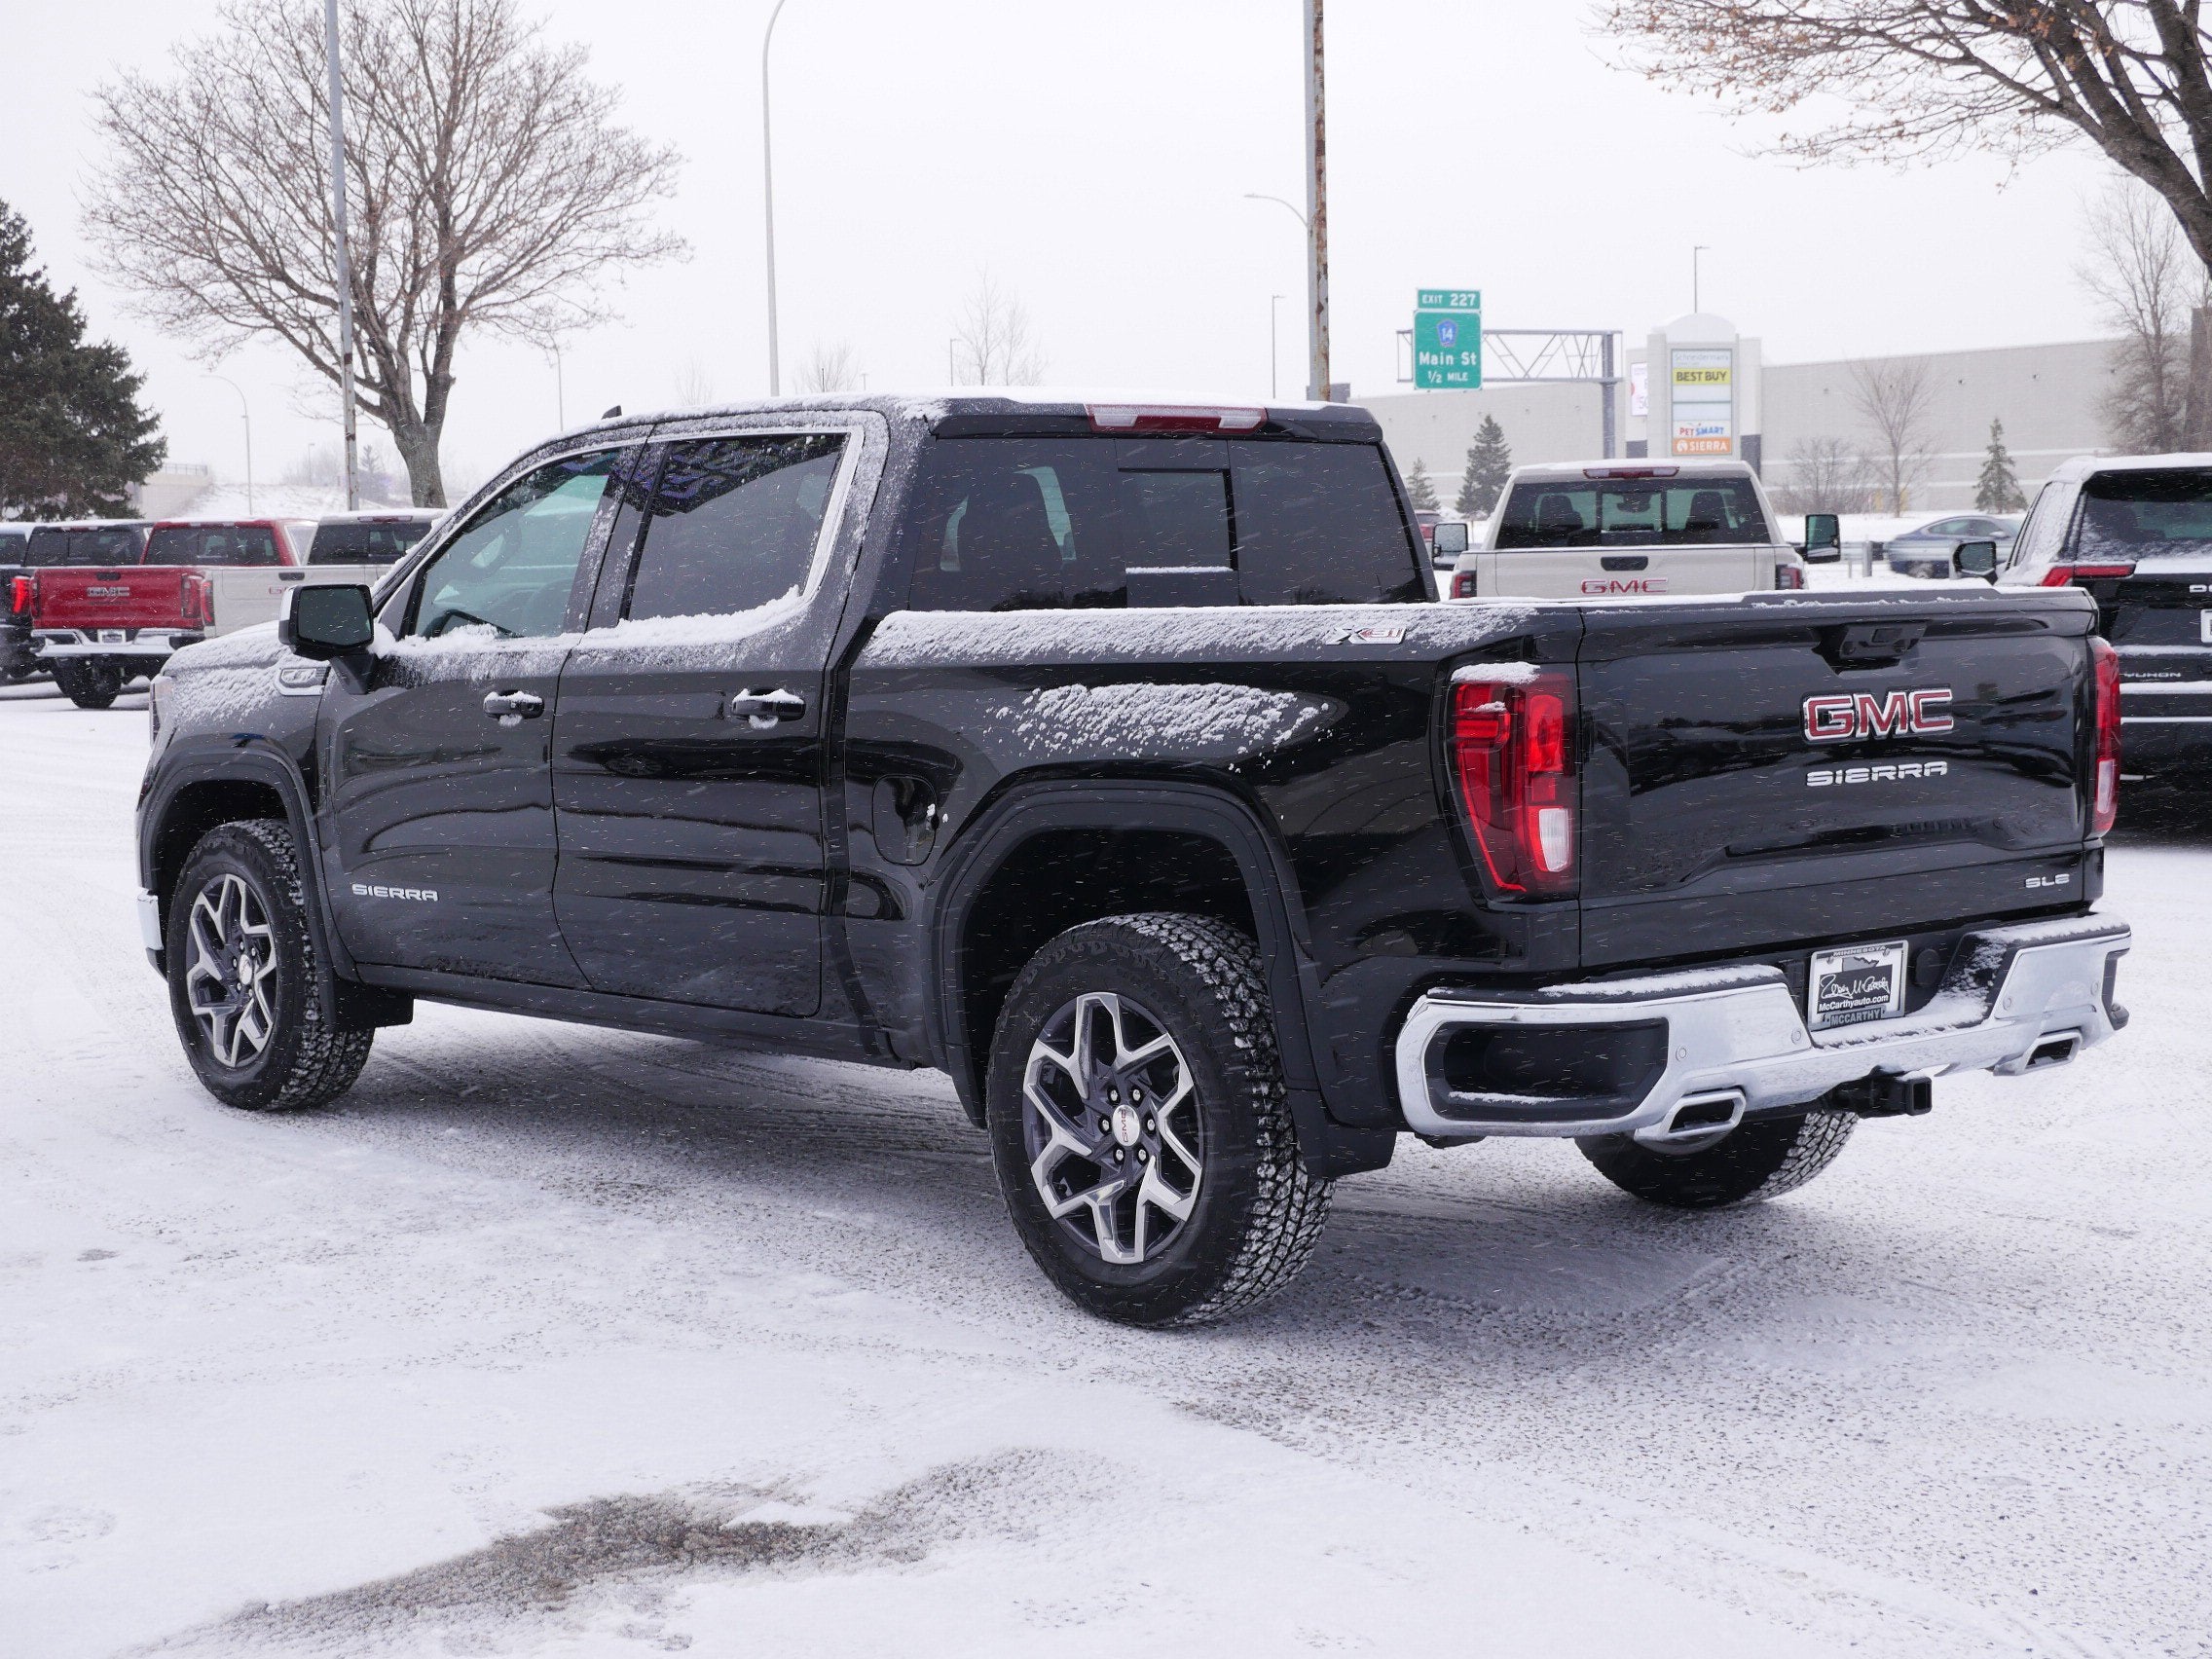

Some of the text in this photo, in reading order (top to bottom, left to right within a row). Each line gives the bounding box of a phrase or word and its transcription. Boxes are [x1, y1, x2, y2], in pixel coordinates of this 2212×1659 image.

[1421, 293, 1477, 307] EXIT 227
[1442, 327, 1454, 341] 14
[1419, 351, 1477, 365] Main St
[1447, 372, 1468, 382] MILE
[1676, 371, 1727, 382] BEST BUY
[1689, 441, 1727, 451] SIERRA
[1581, 578, 1668, 594] GMC
[1803, 688, 1954, 742] GMC
[1806, 760, 1947, 787] SIERRA
[2025, 873, 2070, 889] SLE
[351, 883, 439, 902] SIERRA
[1833, 945, 1886, 957] MINNESOTA
[1819, 994, 1889, 1012] McCarthyauto.com
[1831, 1008, 1881, 1026] MCCARTHY
